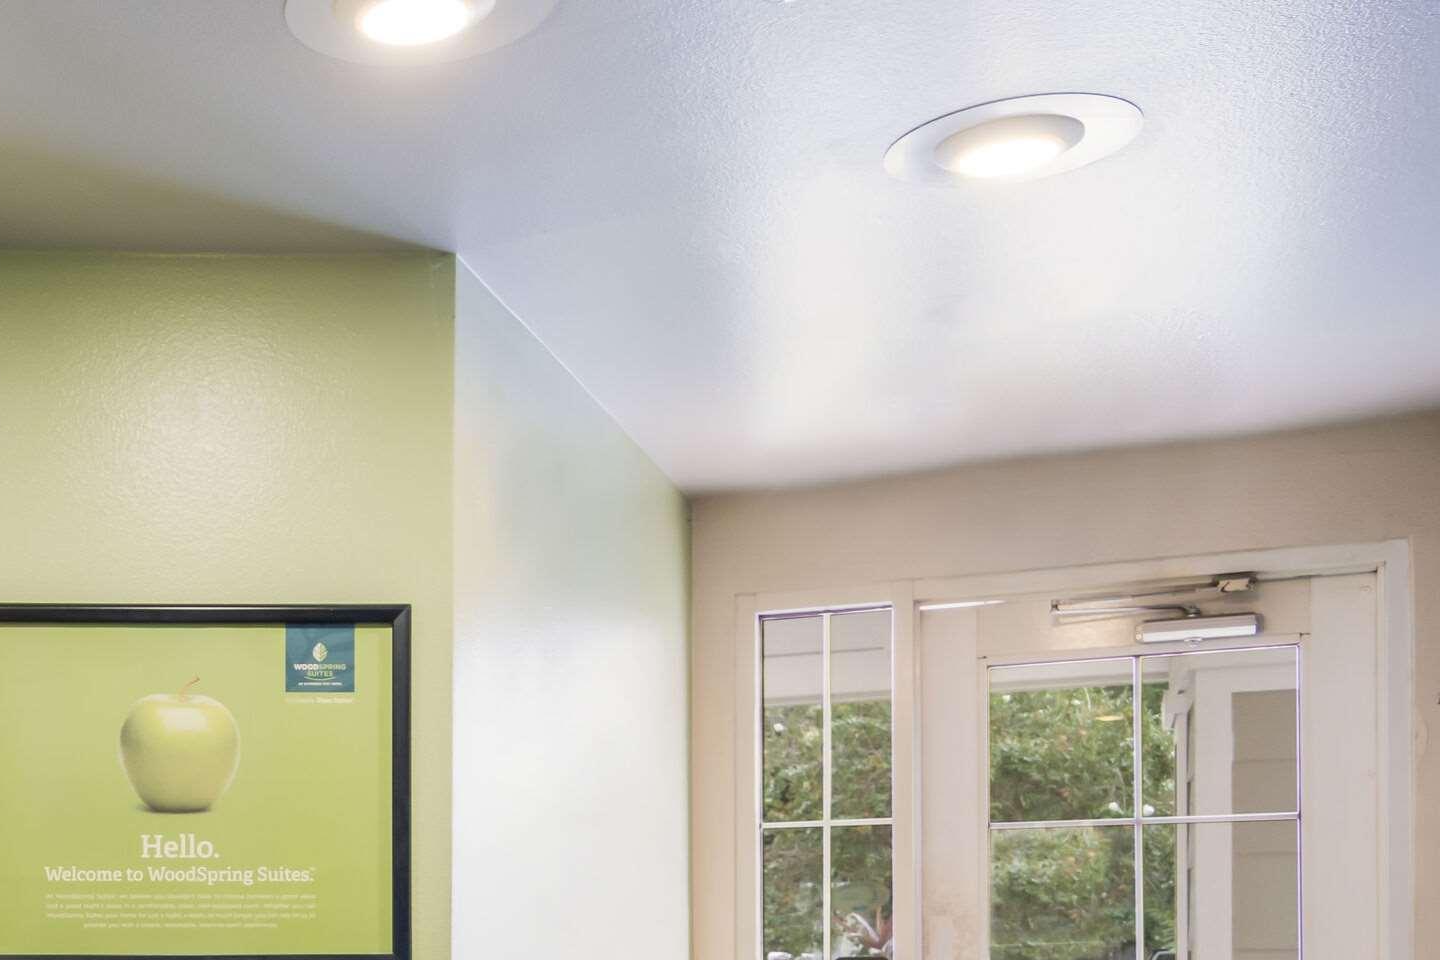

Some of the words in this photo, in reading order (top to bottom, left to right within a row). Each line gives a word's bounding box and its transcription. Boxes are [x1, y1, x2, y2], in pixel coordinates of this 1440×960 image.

[140, 833, 220, 859] Hello.
[44, 866, 122, 882] Welcome
[126, 868, 144, 882] to
[148, 866, 254, 886] WoodSpring
